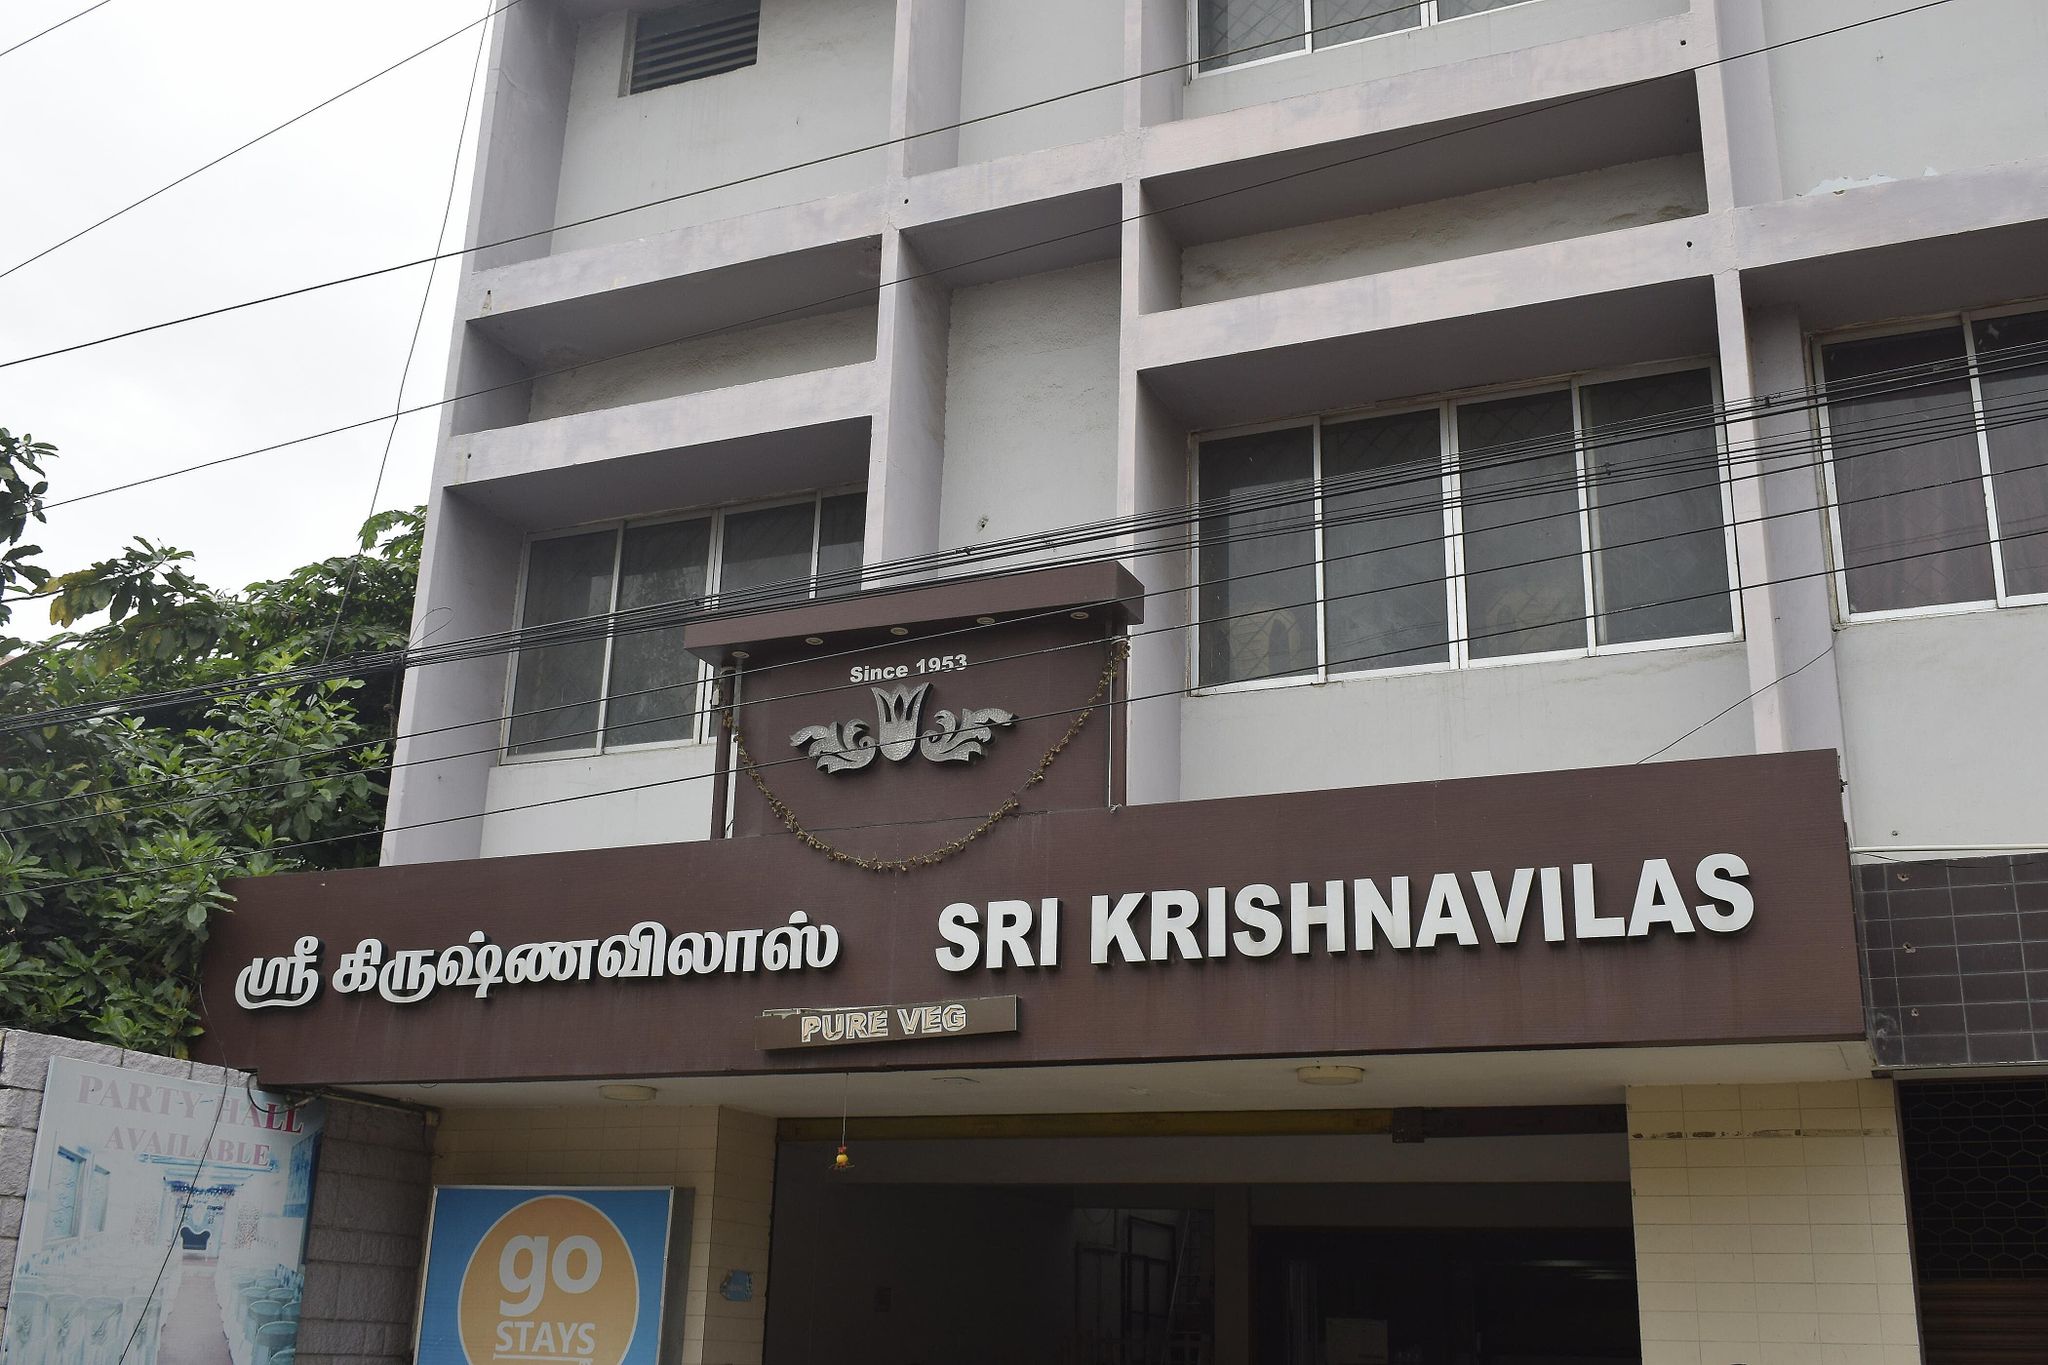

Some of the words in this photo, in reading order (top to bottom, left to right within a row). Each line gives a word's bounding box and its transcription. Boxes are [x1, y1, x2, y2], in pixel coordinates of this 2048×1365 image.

[850, 665, 909, 683] Since
[916, 653, 967, 674] 1953
[935, 900, 1058, 972] SRI
[1091, 853, 1755, 965] KRISHNAVILAS
[332, 910, 839, 1003] கிருஷ்ணவிலாஸ்
[802, 1009, 889, 1042] PURE
[897, 1004, 966, 1034] VEG
[78, 1074, 203, 1119] PARTY
[212, 1095, 304, 1134] HALL
[104, 1125, 270, 1168] AVAILABLE
[499, 1234, 603, 1317] go
[495, 1320, 596, 1354] STAYS
